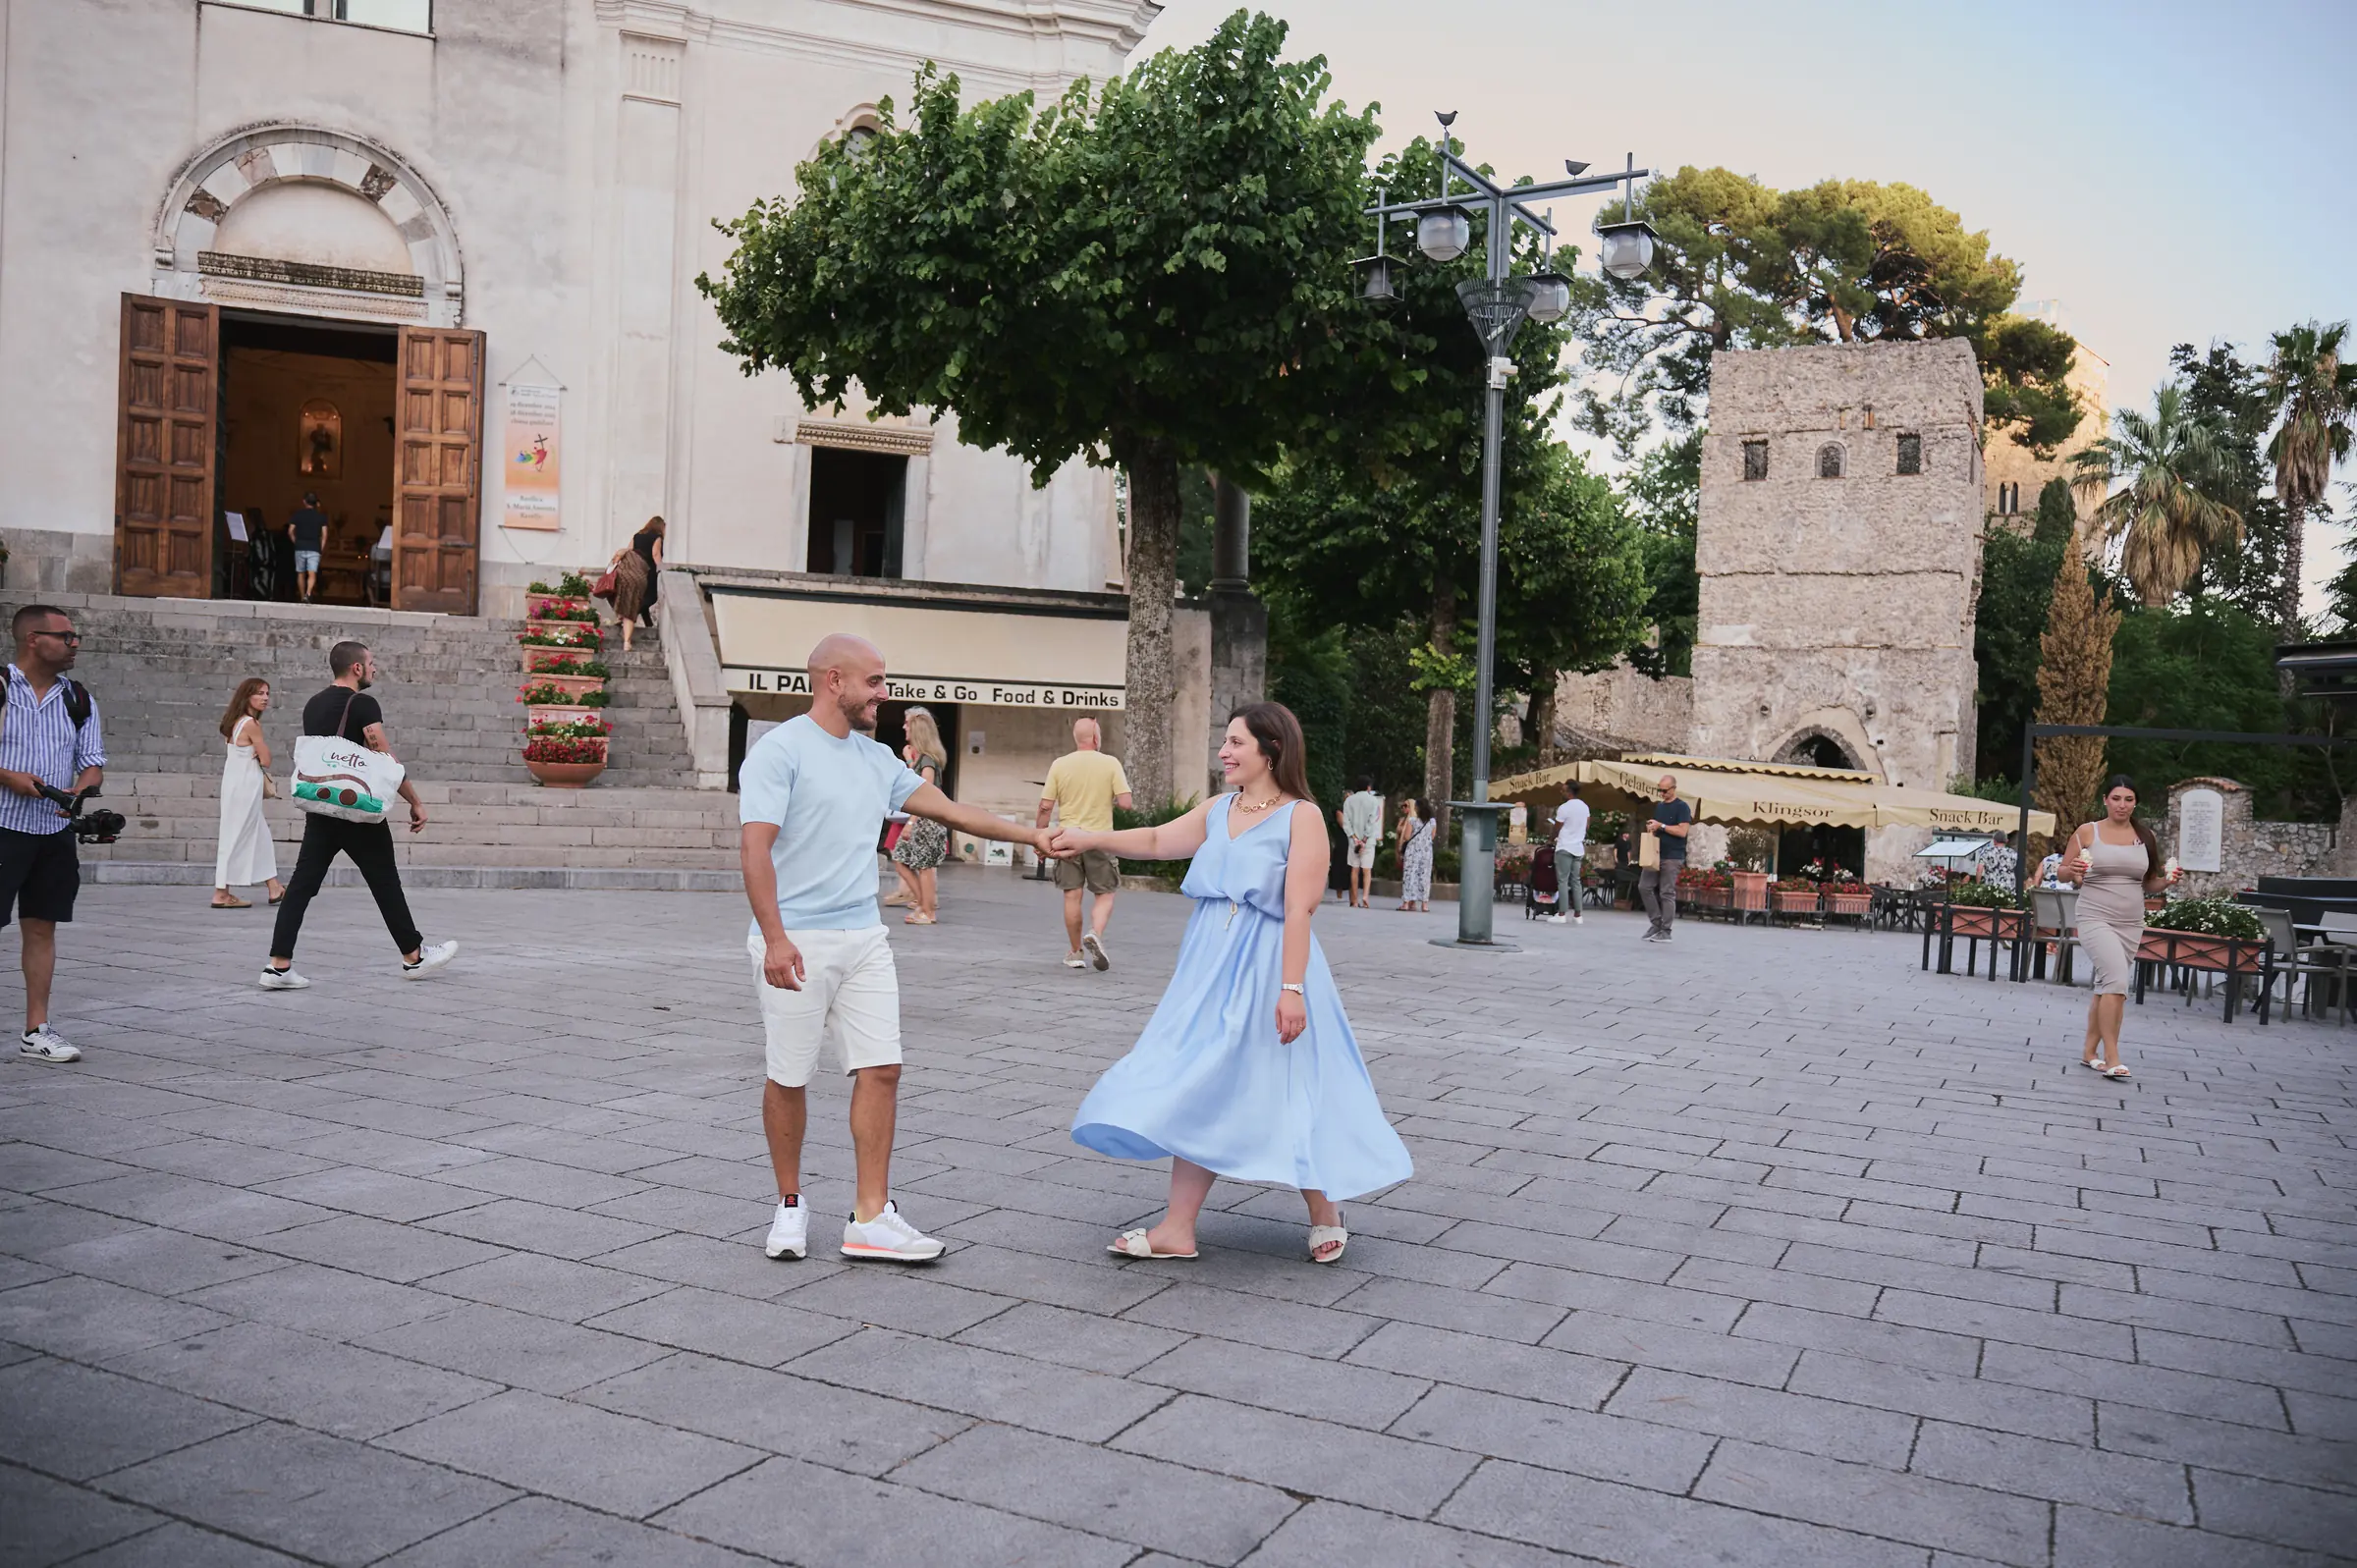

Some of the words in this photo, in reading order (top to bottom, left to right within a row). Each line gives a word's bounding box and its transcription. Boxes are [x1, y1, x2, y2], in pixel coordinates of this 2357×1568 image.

[749, 673, 767, 690] IL
[777, 675, 813, 693] PA
[886, 681, 926, 699] Take
[934, 684, 947, 699] &
[954, 685, 978, 701] Go
[993, 688, 1035, 704] Food
[1043, 690, 1056, 704] &
[1063, 690, 1120, 707] Drinks
[330, 751, 368, 768] netto
[1509, 774, 1533, 791] Snack
[1535, 772, 1552, 784] Bar
[1753, 801, 1835, 818] Klingsor
[1929, 808, 1972, 824] Snack
[1978, 811, 2003, 826] Bar
